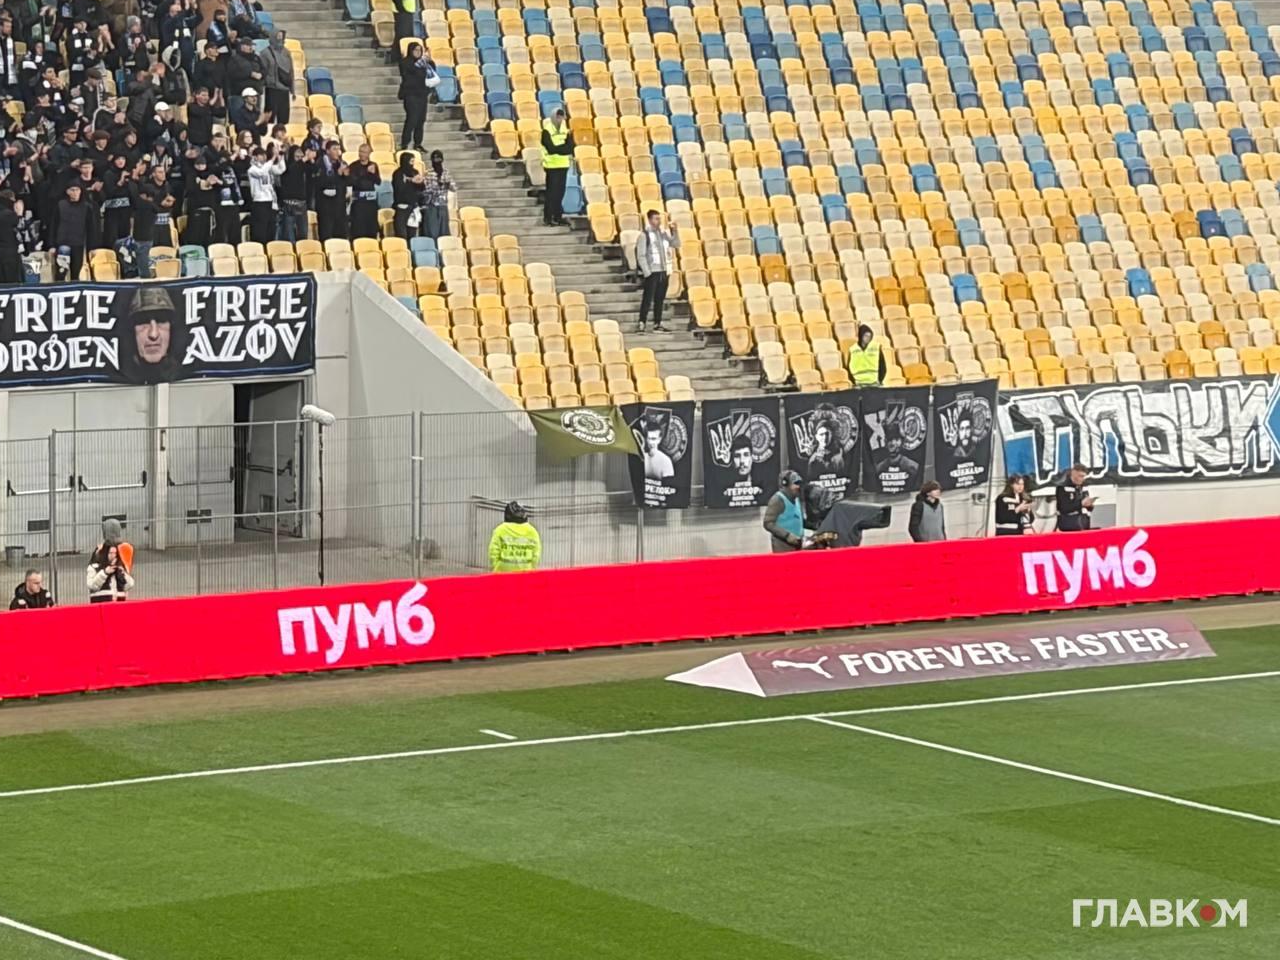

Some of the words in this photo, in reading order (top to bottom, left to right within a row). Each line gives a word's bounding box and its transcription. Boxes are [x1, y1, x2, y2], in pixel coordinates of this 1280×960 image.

[182, 282, 308, 325] FREE
[181, 319, 307, 365] AZOV
[838, 640, 1031, 677] FOREVER.
[1031, 627, 1190, 660] FASTER.
